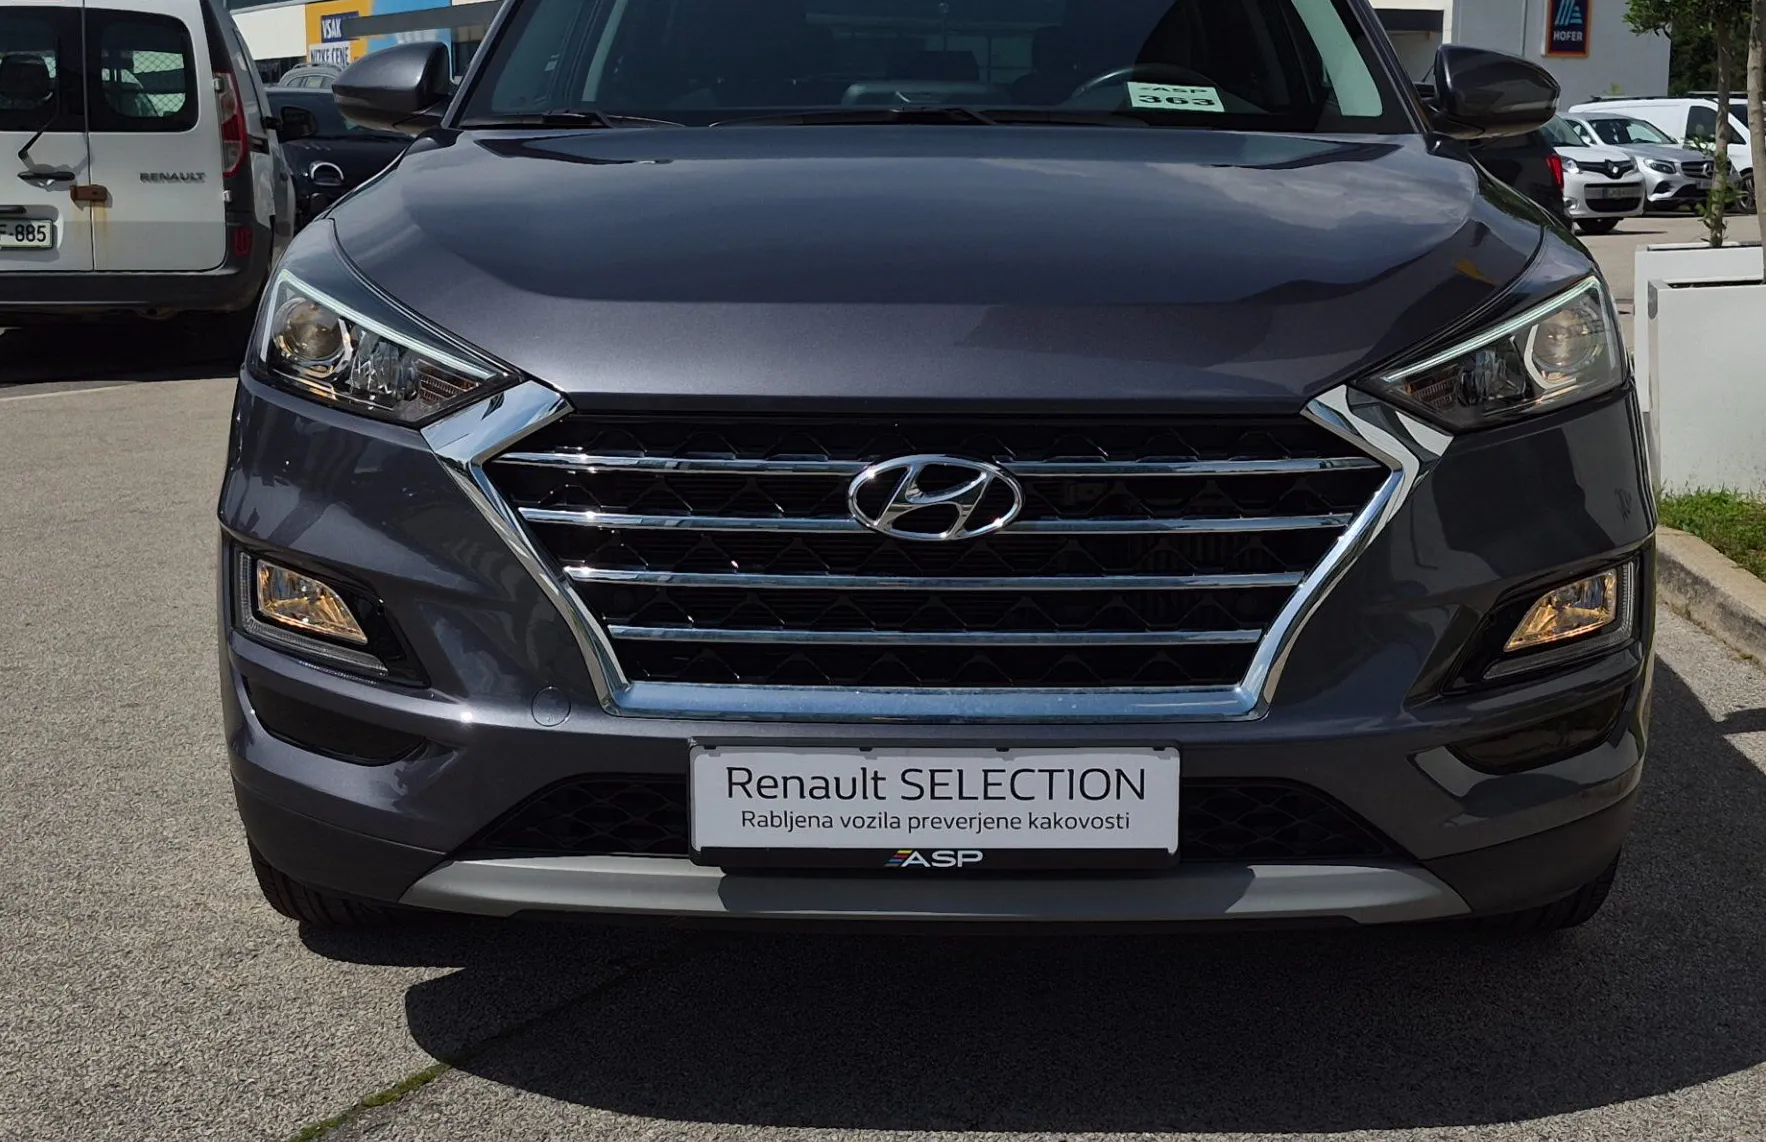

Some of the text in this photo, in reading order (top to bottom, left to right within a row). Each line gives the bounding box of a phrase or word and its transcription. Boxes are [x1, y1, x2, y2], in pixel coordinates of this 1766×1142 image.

[322, 18, 342, 39] VSAK
[1553, 30, 1583, 41] HOFER
[1138, 95, 1215, 106] 363
[140, 172, 206, 183] RENAULT
[726, 766, 1145, 801] Renault SELECTION
[741, 810, 1130, 835] Rabljena vozila preverjene kakovosti
[900, 850, 984, 868] ASP
